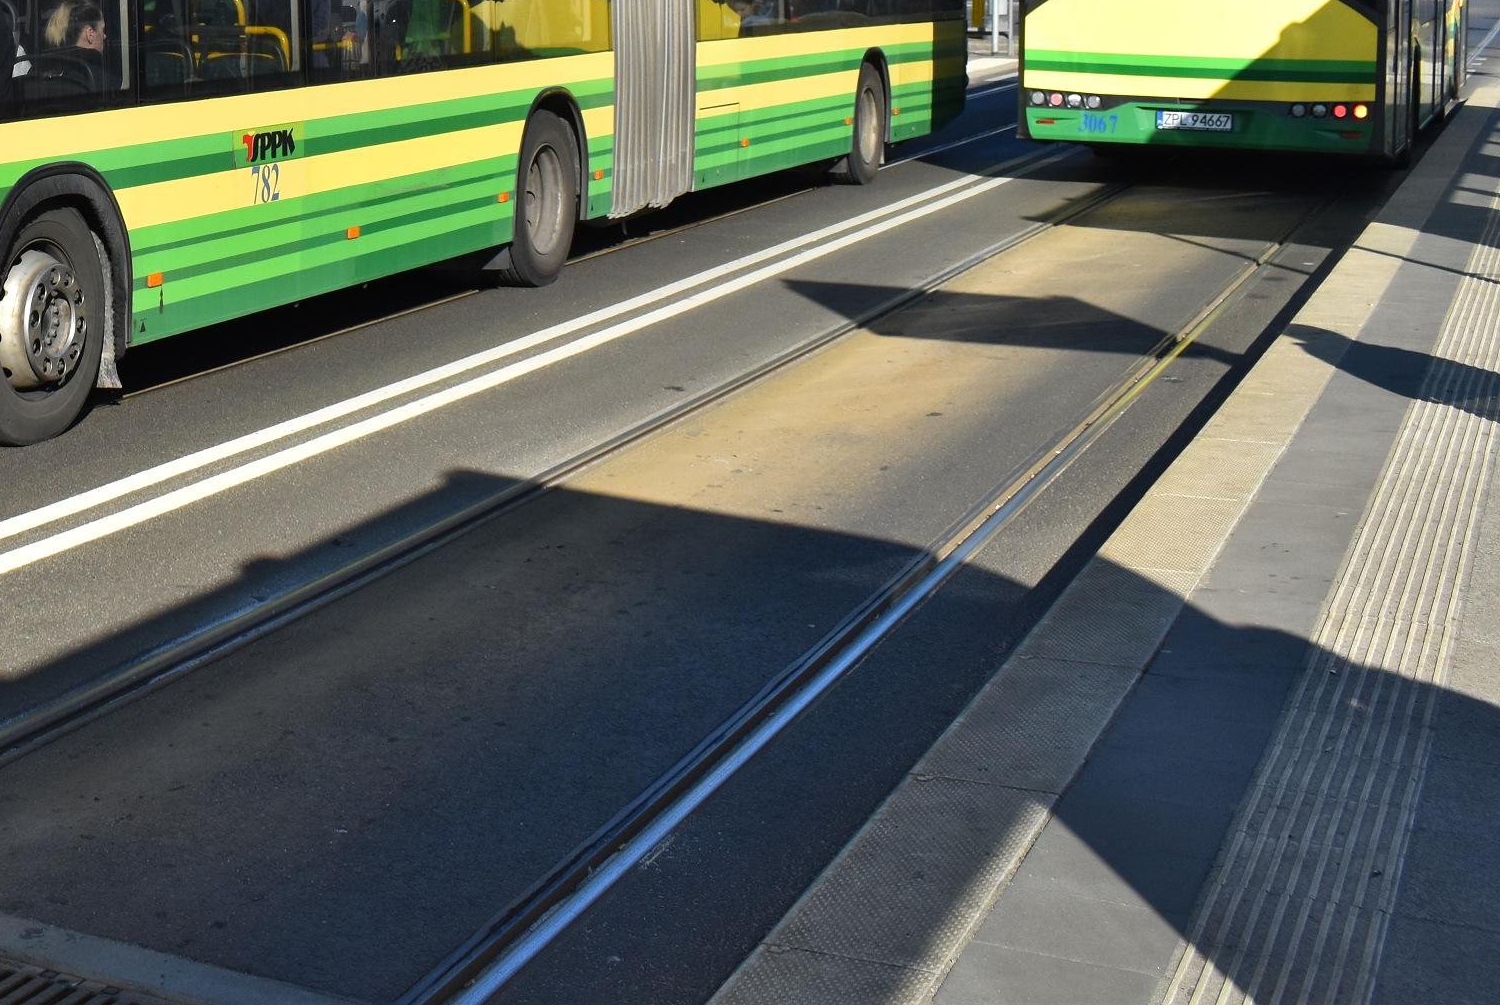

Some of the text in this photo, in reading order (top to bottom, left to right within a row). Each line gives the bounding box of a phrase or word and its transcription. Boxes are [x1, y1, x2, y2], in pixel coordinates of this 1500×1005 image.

[1079, 112, 1119, 133] 3067
[1164, 113, 1231, 128] ZPL 94667
[251, 163, 280, 204] 782
